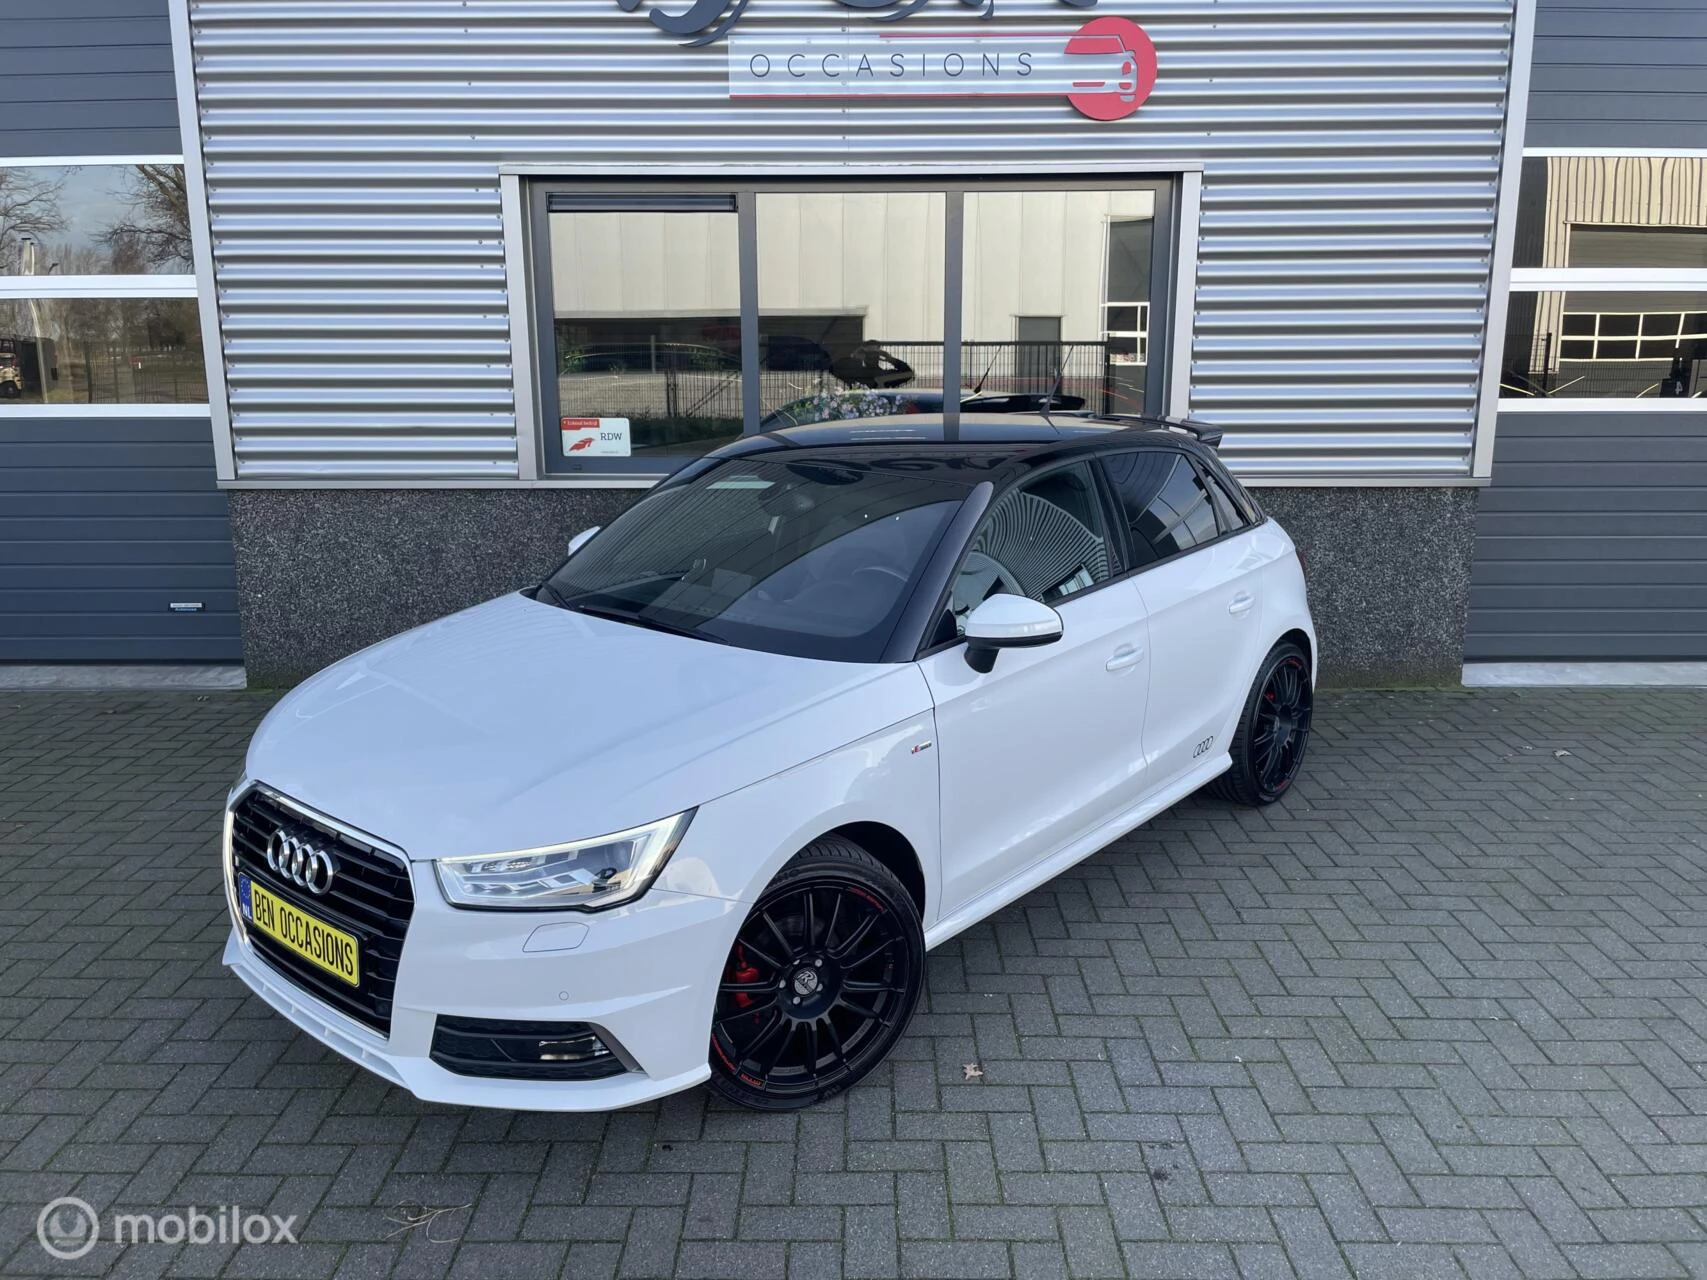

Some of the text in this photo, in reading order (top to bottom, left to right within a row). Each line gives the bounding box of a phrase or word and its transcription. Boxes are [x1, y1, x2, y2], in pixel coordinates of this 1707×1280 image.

[749, 52, 1033, 77] OCCASIONS
[600, 432, 622, 440] RDW
[242, 903, 252, 919] NL
[254, 889, 353, 976] BEN OCCASIONS
